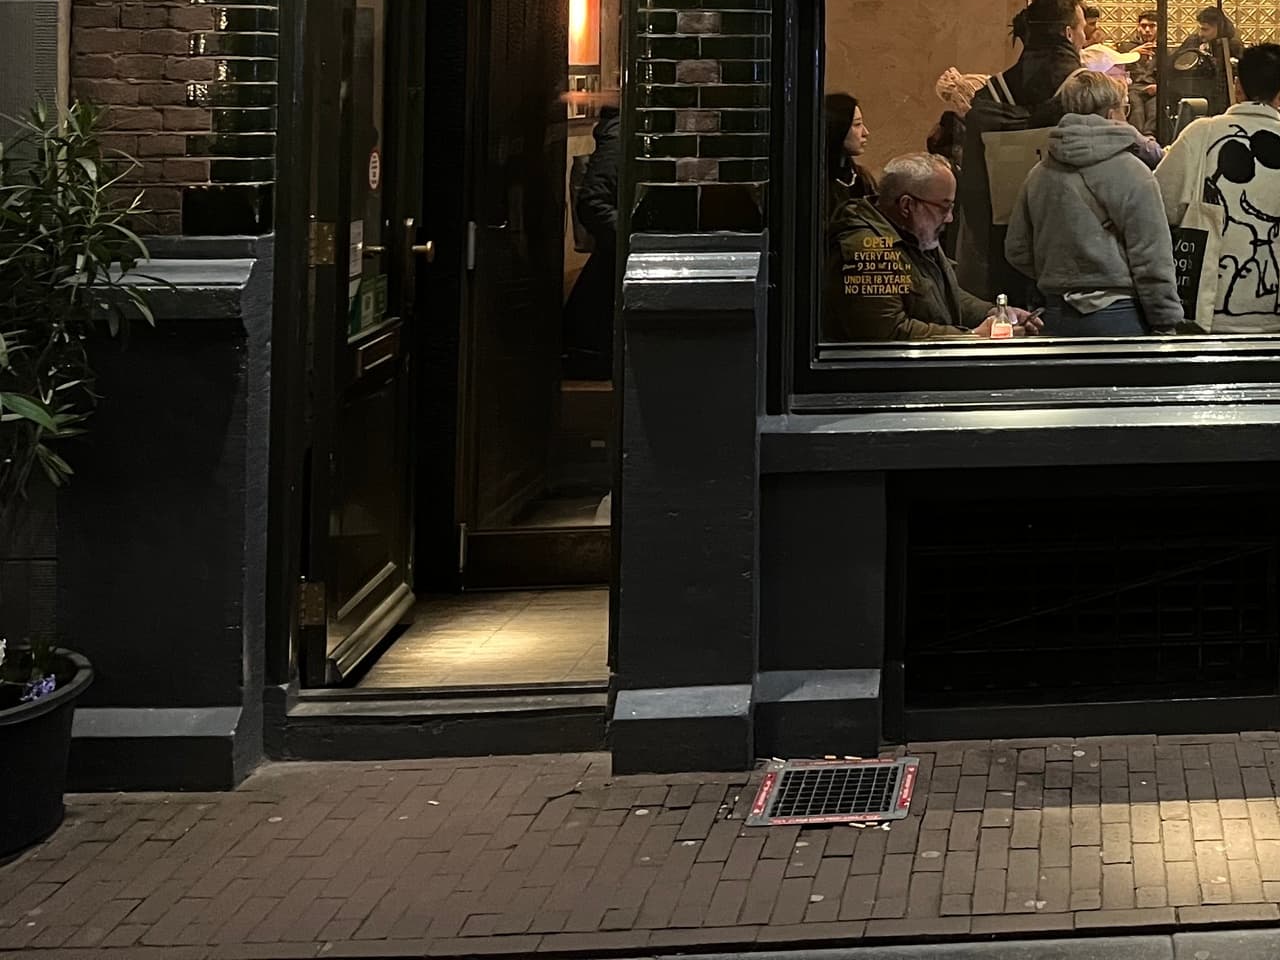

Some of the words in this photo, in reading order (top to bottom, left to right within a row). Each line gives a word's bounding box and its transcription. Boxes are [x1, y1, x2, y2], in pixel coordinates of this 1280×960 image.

[864, 237, 893, 248] OPEN
[854, 251, 883, 260] EVERY
[884, 251, 901, 260] DAY
[843, 275, 872, 284] UNDER
[874, 275, 883, 284] 18
[884, 275, 912, 284] YEARS
[845, 285, 859, 294] NO
[861, 285, 910, 294] ENTRANCE
